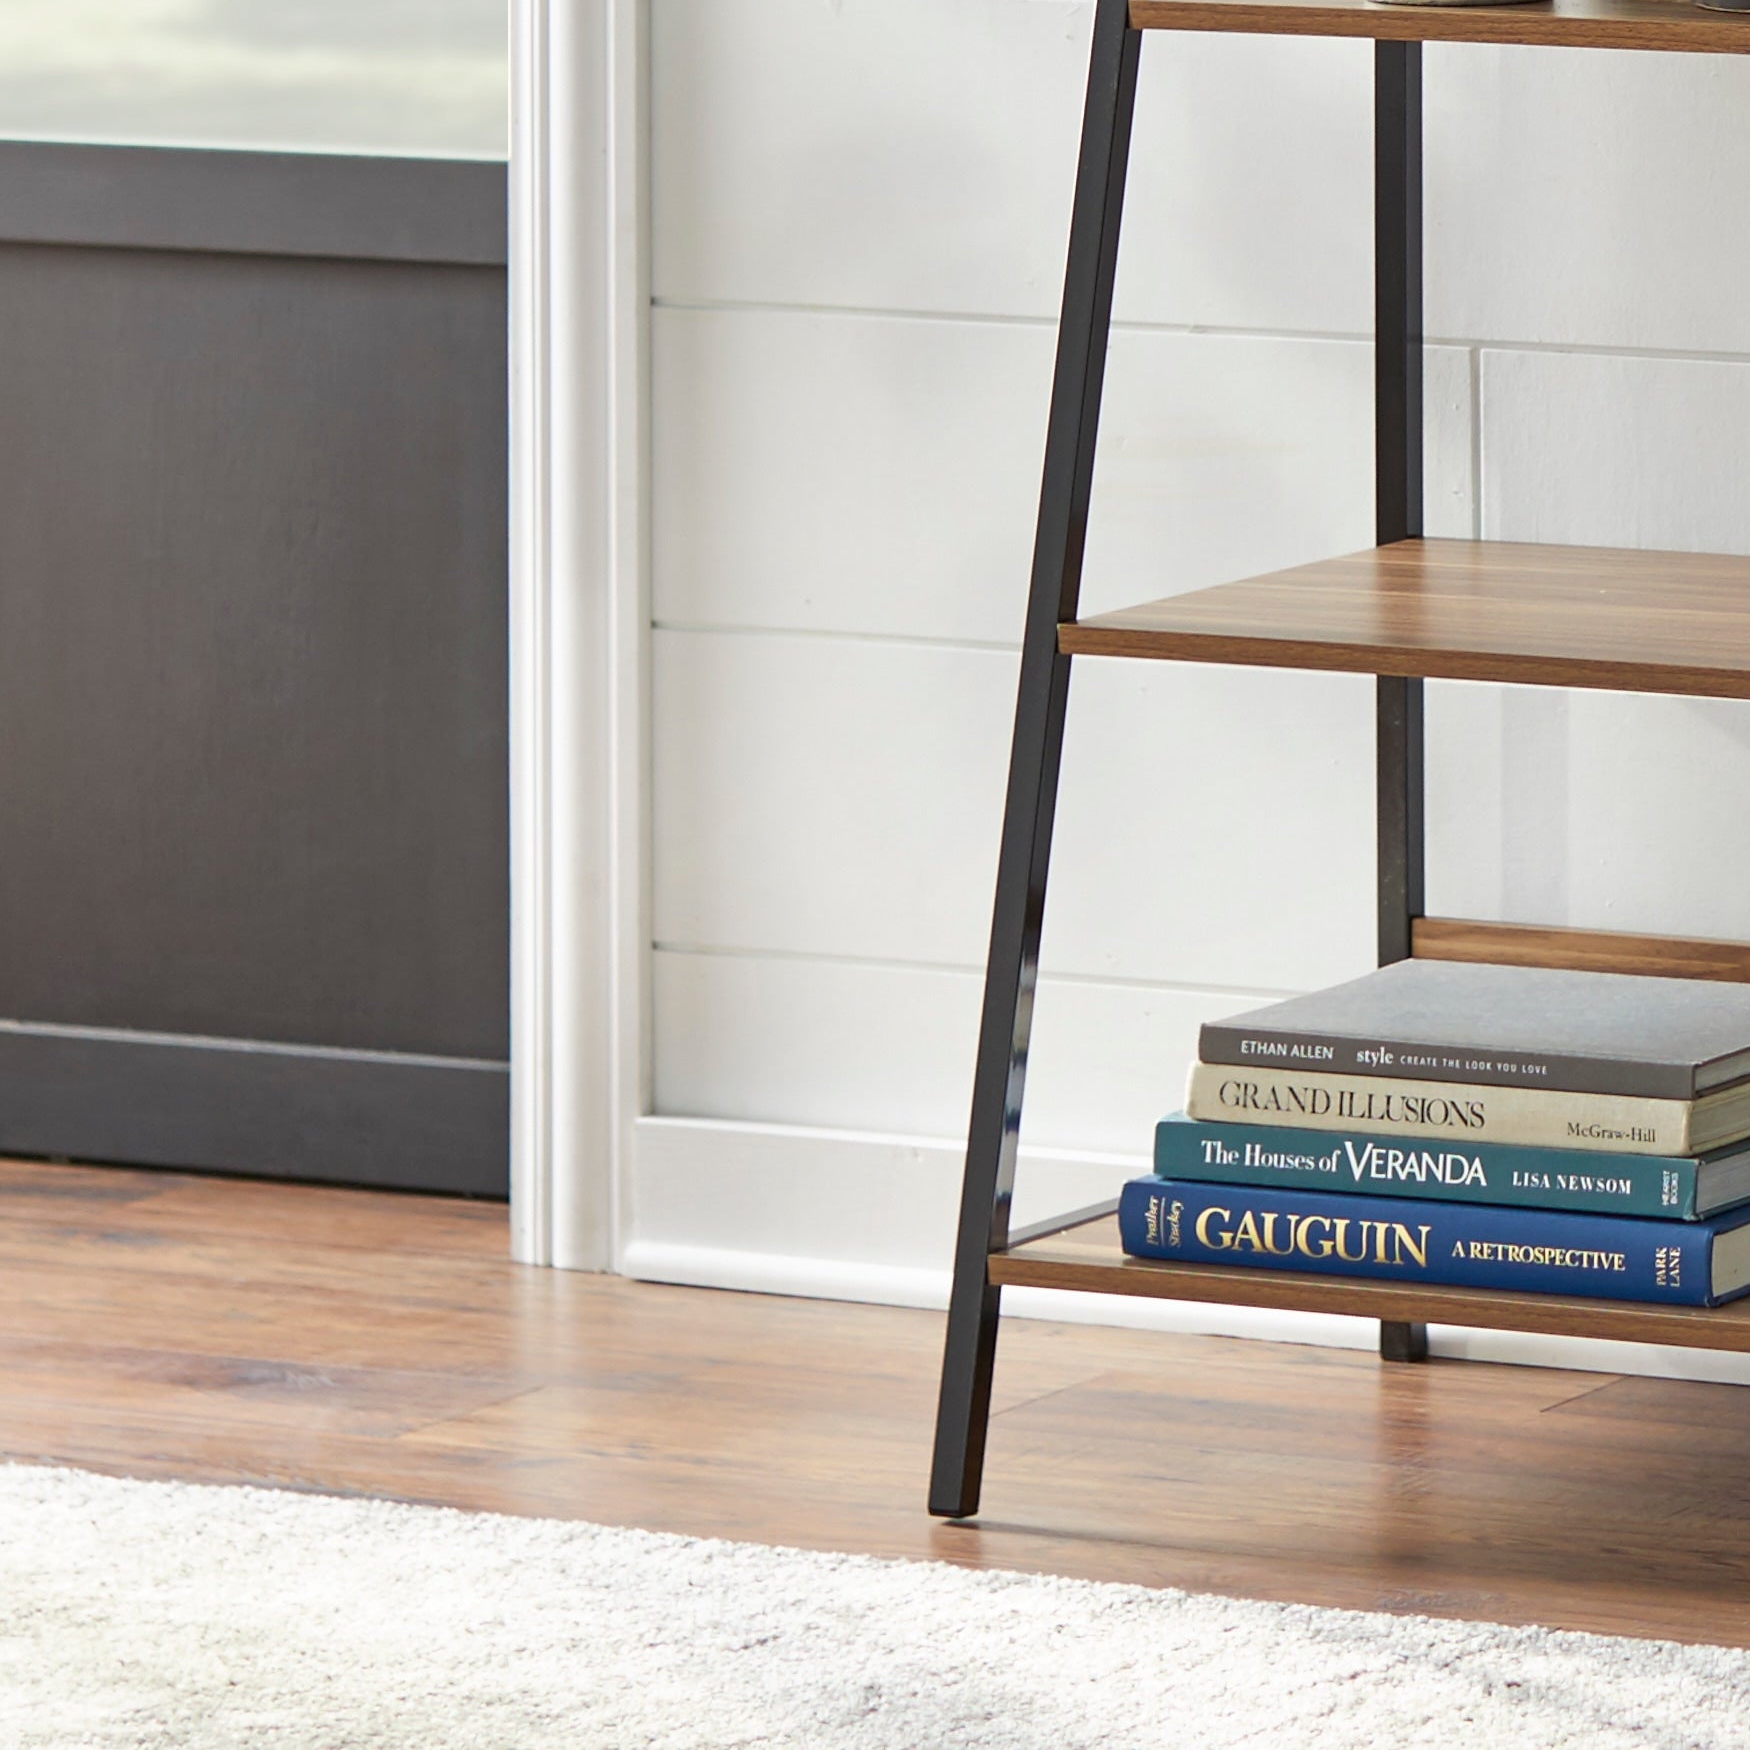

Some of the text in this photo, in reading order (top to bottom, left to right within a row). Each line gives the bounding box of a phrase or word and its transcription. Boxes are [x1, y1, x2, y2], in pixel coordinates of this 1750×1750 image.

[1241, 1040, 1334, 1060] ETHAN ALLEN
[1356, 1046, 1394, 1067] style
[1400, 1055, 1548, 1075] CREATE THE LOOK YOU LOVE
[1219, 1080, 1485, 1129] GRAND ILLUSIONS
[1567, 1122, 1656, 1143] McGraw-Hill
[1201, 1139, 1488, 1187] The Houses of VERANDA
[1512, 1171, 1632, 1195] LISA NEWSOM
[1195, 1206, 1432, 1268] GAUGUIN
[1451, 1240, 1626, 1272] A RETROSPECTIVE
[1655, 1247, 1668, 1286] PARK
[1669, 1246, 1681, 1288] LANE
